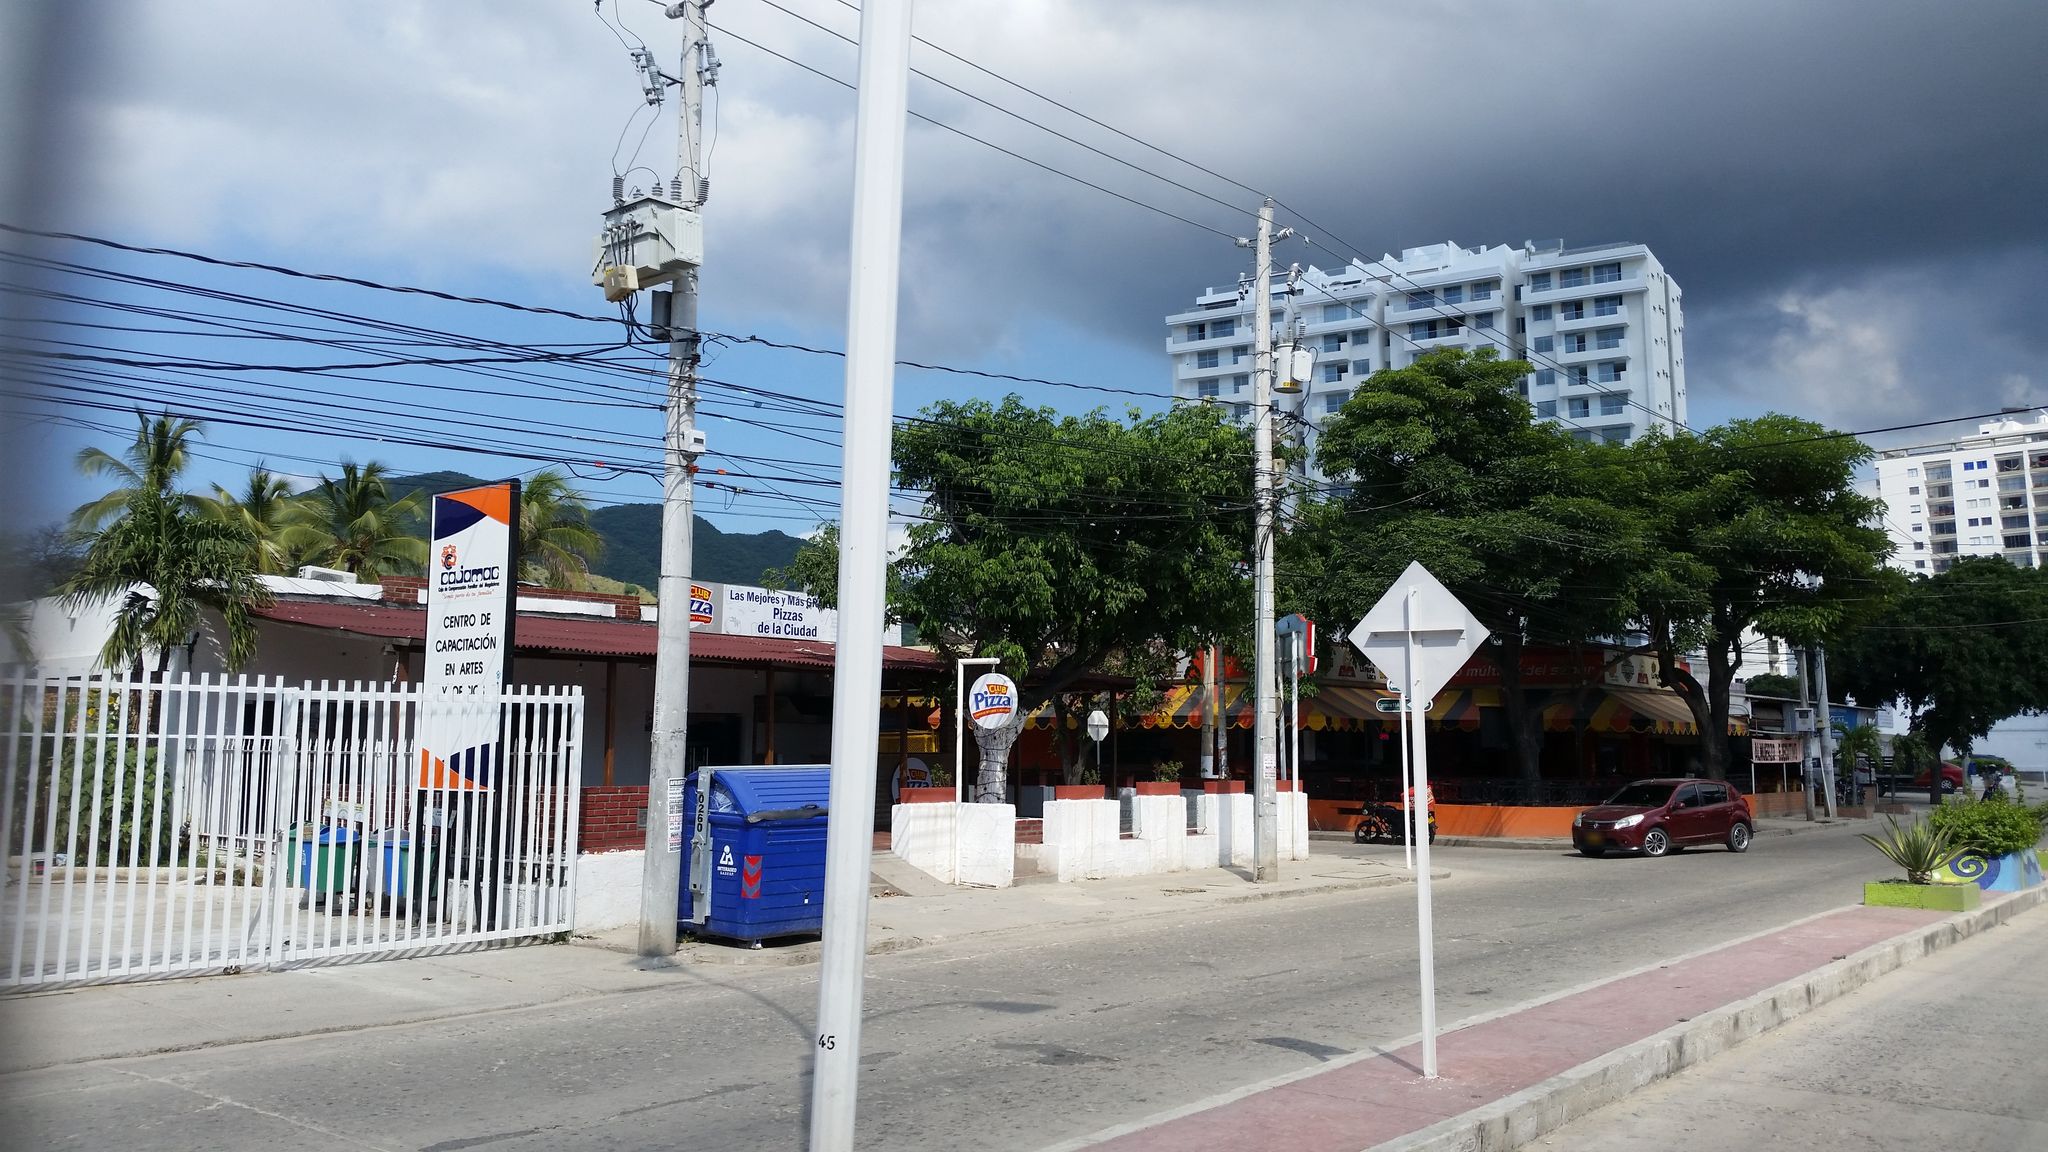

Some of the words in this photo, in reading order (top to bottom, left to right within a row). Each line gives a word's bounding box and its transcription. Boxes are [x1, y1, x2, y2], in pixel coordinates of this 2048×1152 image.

[730, 590, 744, 601] Las
[747, 592, 780, 605] Mejores
[781, 597, 786, 606] y
[788, 595, 804, 606] Más
[444, 614, 476, 628] CENTRO
[480, 612, 491, 626] DE
[773, 608, 803, 622] Pizzas
[758, 622, 770, 634] de
[772, 622, 781, 634] la
[784, 624, 817, 637] Ciudad
[436, 632, 496, 652] CAPACITACIÓN
[445, 663, 456, 676] EN
[460, 661, 484, 675] ARTES
[1526, 665, 1546, 676] del
[989, 686, 1006, 694] CLUB
[974, 691, 1010, 710] Pizza
[696, 794, 705, 832] 0260
[818, 1034, 836, 1050] 45
